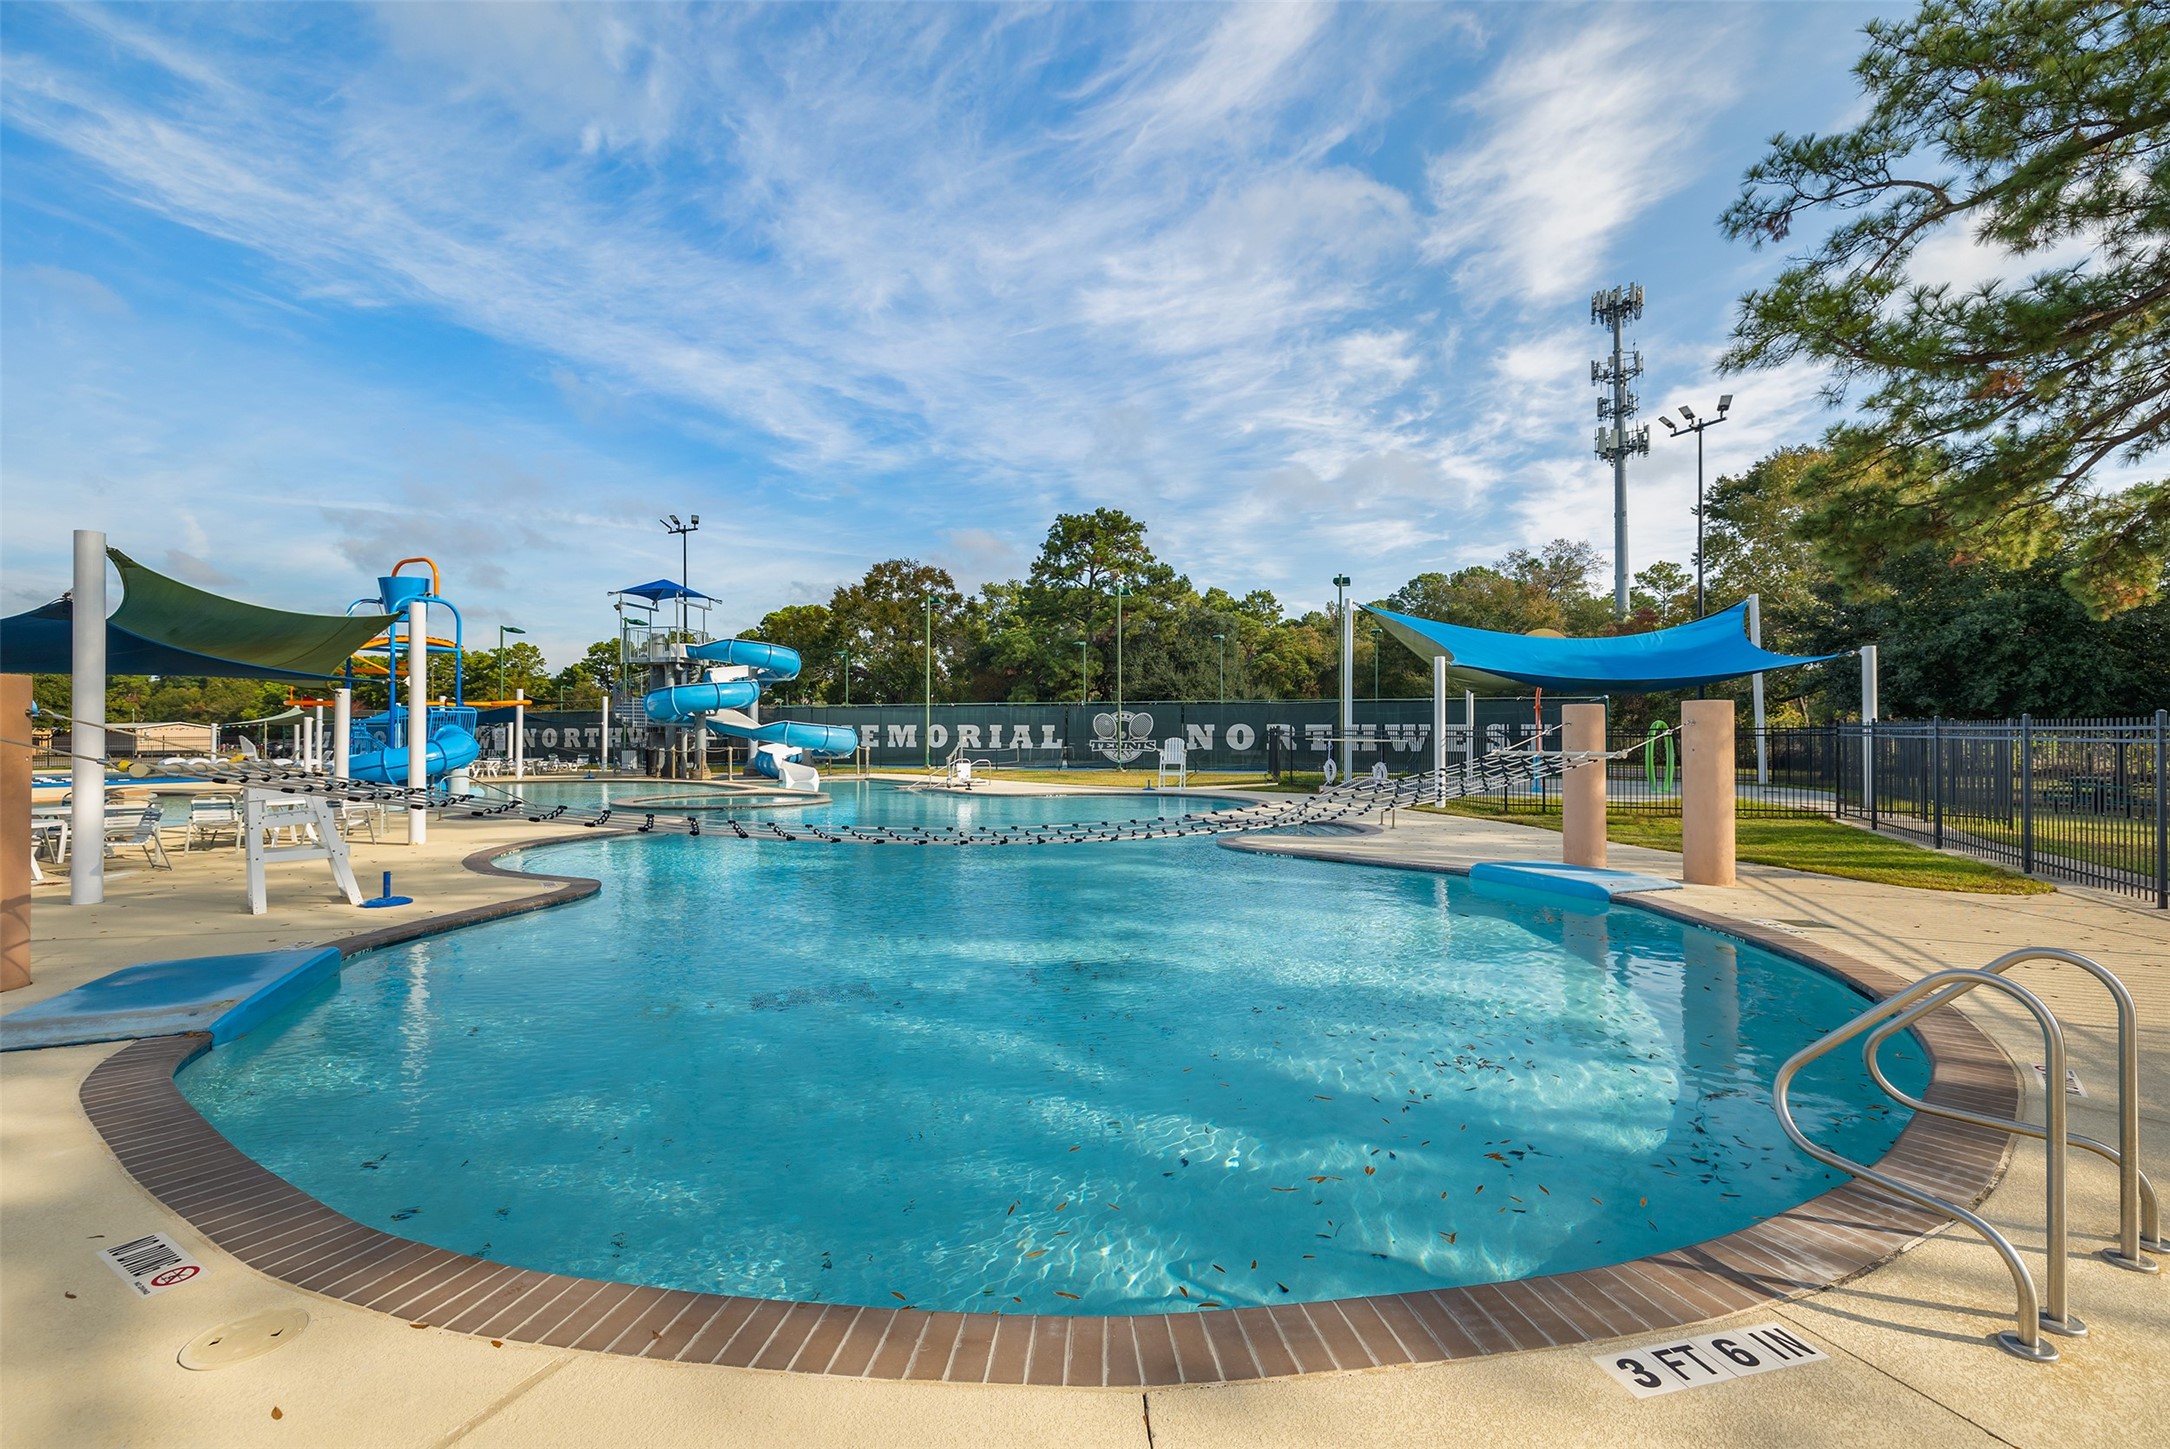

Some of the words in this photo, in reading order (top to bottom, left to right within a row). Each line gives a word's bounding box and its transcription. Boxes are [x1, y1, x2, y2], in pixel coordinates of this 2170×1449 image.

[839, 724, 1063, 749] EMORIAL
[1090, 740, 1156, 751] TENNIS
[107, 1234, 160, 1257] NO
[116, 1243, 183, 1277] DIVING
[1616, 1358, 1662, 1388] 3
[1651, 1344, 1717, 1380] FT
[1711, 1339, 1760, 1367] 6
[1748, 1327, 1817, 1360] IN
